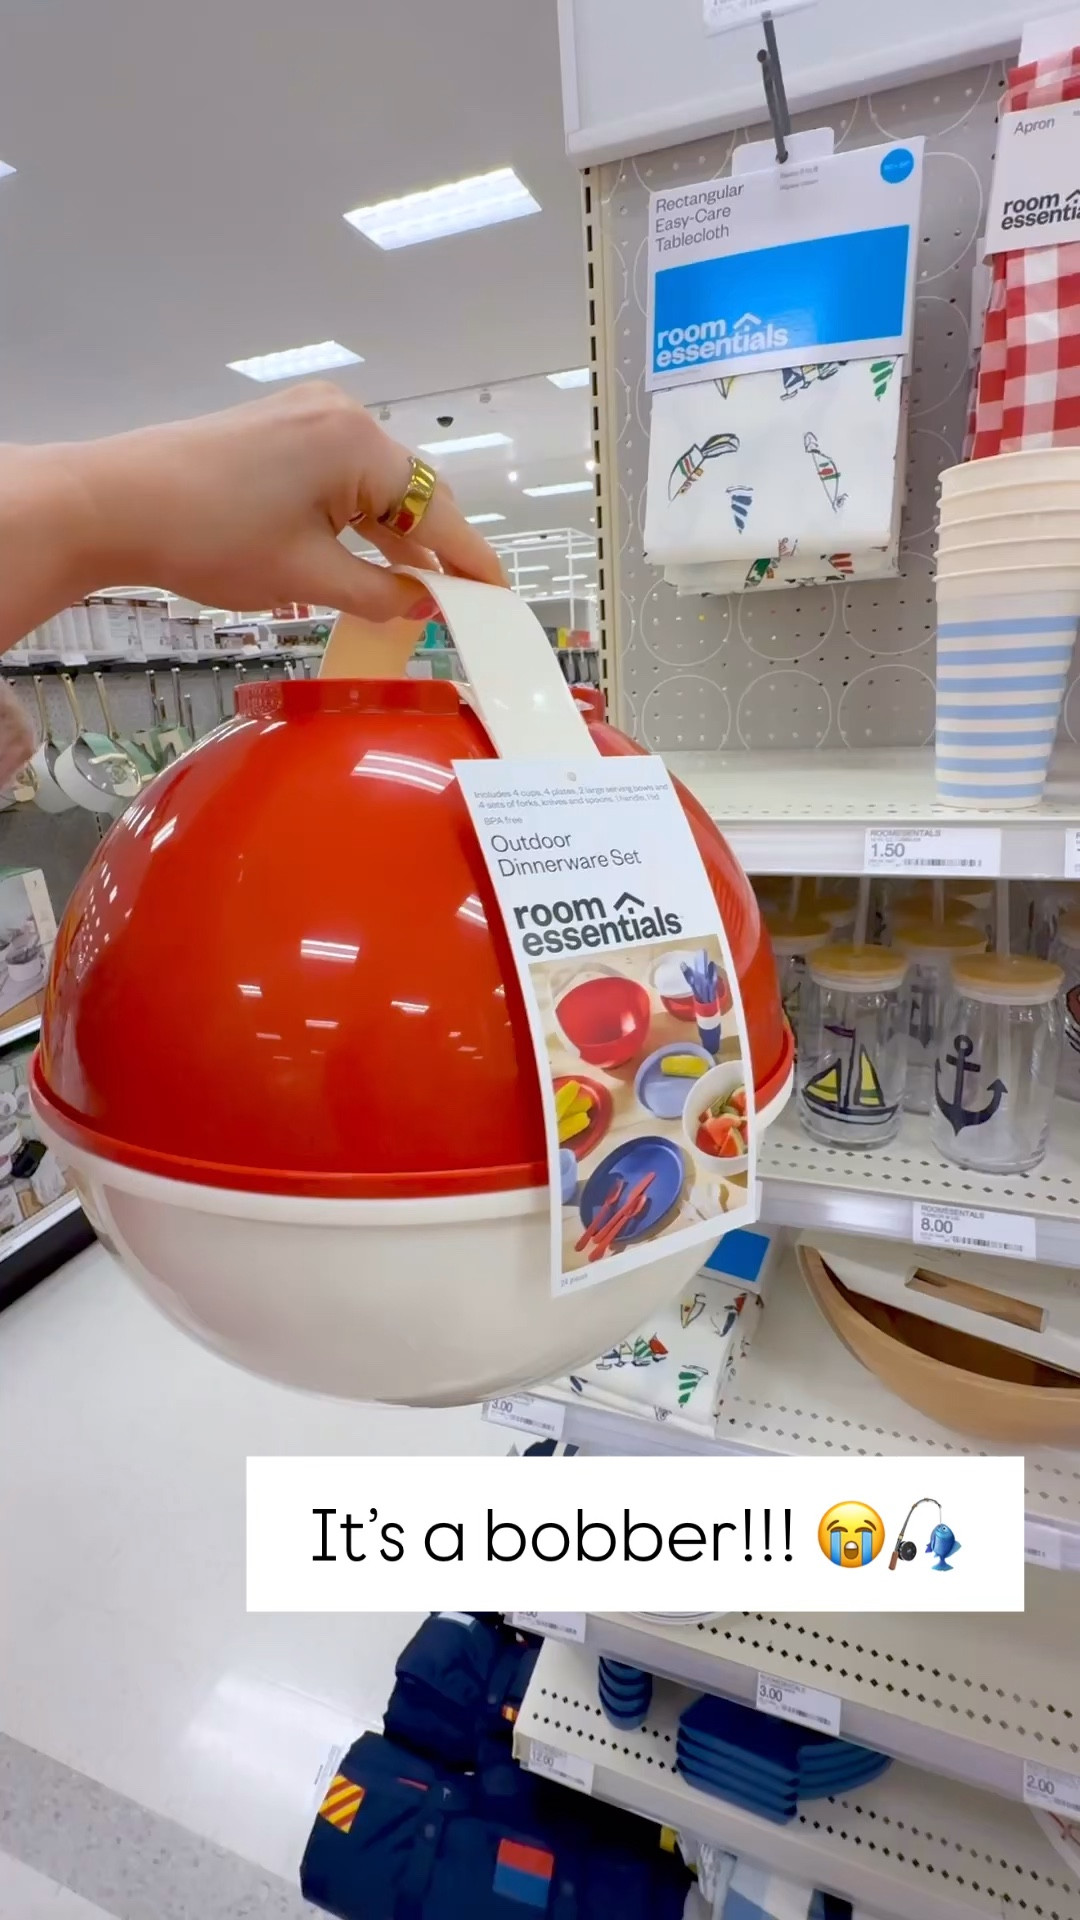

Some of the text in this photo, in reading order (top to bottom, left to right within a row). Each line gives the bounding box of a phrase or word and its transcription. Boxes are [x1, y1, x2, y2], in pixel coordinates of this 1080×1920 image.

[1014, 117, 1055, 135] Apron
[656, 184, 744, 214] Rectangular
[1003, 193, 1060, 215] room
[656, 206, 731, 234] Easy-Care
[655, 224, 729, 252] Tablecloth
[656, 323, 789, 367] essentials
[658, 319, 726, 349] room
[655, 783, 668, 791] and
[506, 799, 516, 808] of
[569, 797, 584, 805] and
[504, 815, 523, 825] free
[491, 832, 572, 853] Outdoor
[871, 842, 905, 858] 1.50
[498, 849, 642, 877] Dinnerware Set
[513, 897, 607, 930] room
[522, 906, 682, 956] essentials
[921, 1217, 953, 1234] 8.00
[759, 1685, 783, 1702] 3.00
